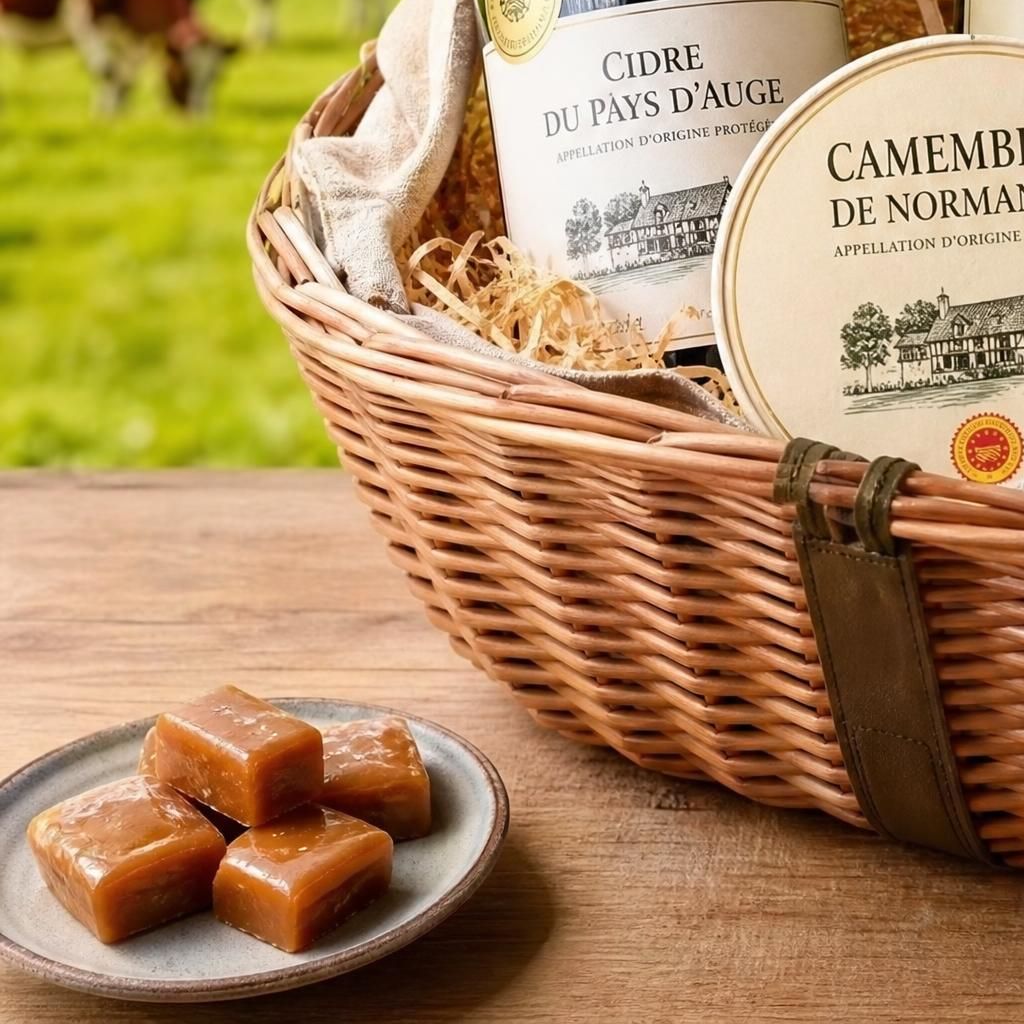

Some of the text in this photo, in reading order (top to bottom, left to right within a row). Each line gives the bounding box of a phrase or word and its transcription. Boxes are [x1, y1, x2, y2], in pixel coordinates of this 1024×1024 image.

[601, 43, 704, 82] CIDRE
[544, 78, 785, 138] DU PAYS D'AUGE
[556, 138, 635, 164] APPELLATION
[639, 128, 711, 147] D'ORIGINE
[830, 197, 876, 229] DE
[833, 237, 936, 258] APPELLATION
[941, 230, 1021, 249] D'ORIGINE
